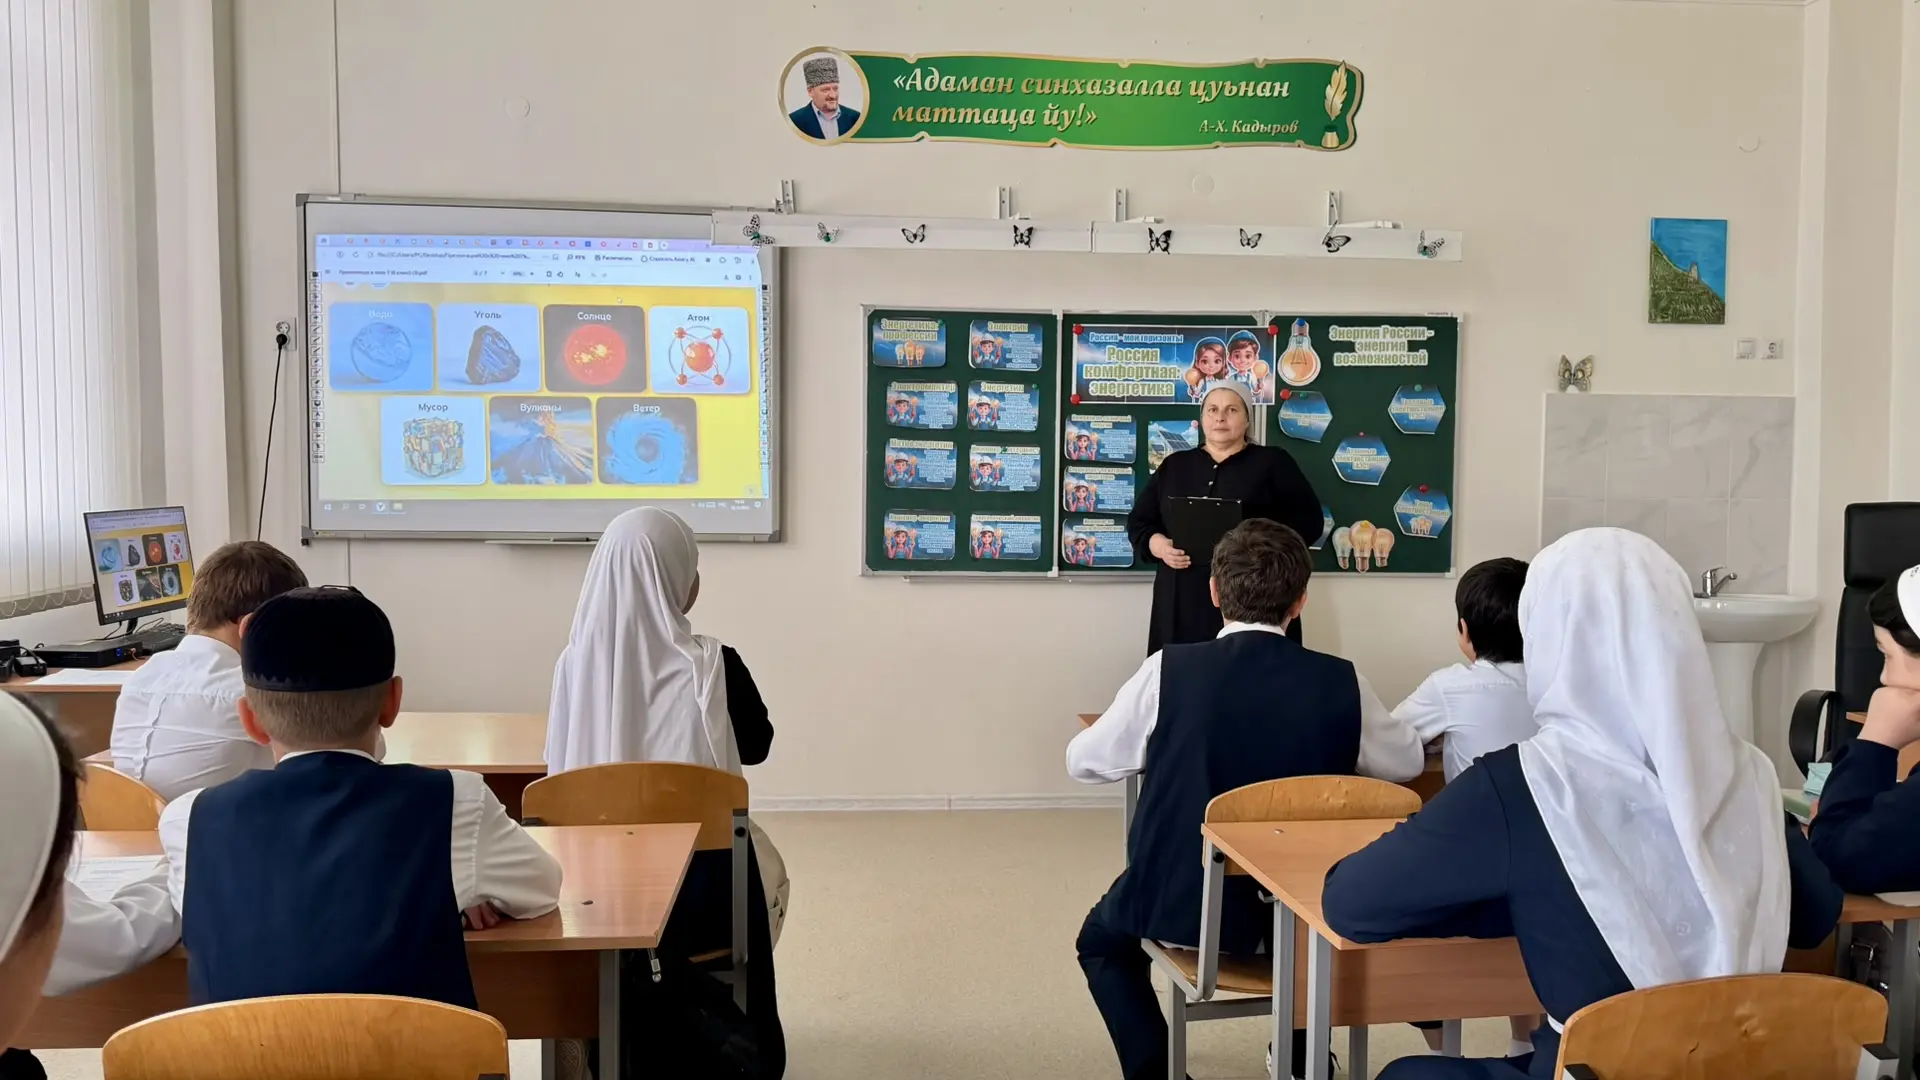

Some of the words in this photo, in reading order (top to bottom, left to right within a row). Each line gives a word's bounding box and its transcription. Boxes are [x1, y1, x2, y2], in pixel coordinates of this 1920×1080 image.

[893, 66, 1014, 93] «Адаман
[1021, 77, 1182, 97] синхазалла
[1189, 79, 1290, 104] цуьнан
[892, 106, 1036, 132] маттаца
[1042, 102, 1097, 132] йу!»
[1231, 119, 1299, 136] Кадыров
[474, 310, 502, 320] Уголь
[577, 311, 612, 322] Солнце
[687, 313, 710, 322] Атом
[1090, 333, 1119, 342] Россия
[1330, 326, 1380, 340] Энергия
[1356, 340, 1406, 353] энергия
[1107, 346, 1159, 361] Россия
[1334, 350, 1427, 365] возможностей
[1084, 364, 1181, 380] комфортная:
[1090, 381, 1174, 396] энергетика
[418, 403, 448, 413] Мусор
[520, 403, 562, 413] Вулканы
[633, 404, 660, 413] Ветер
